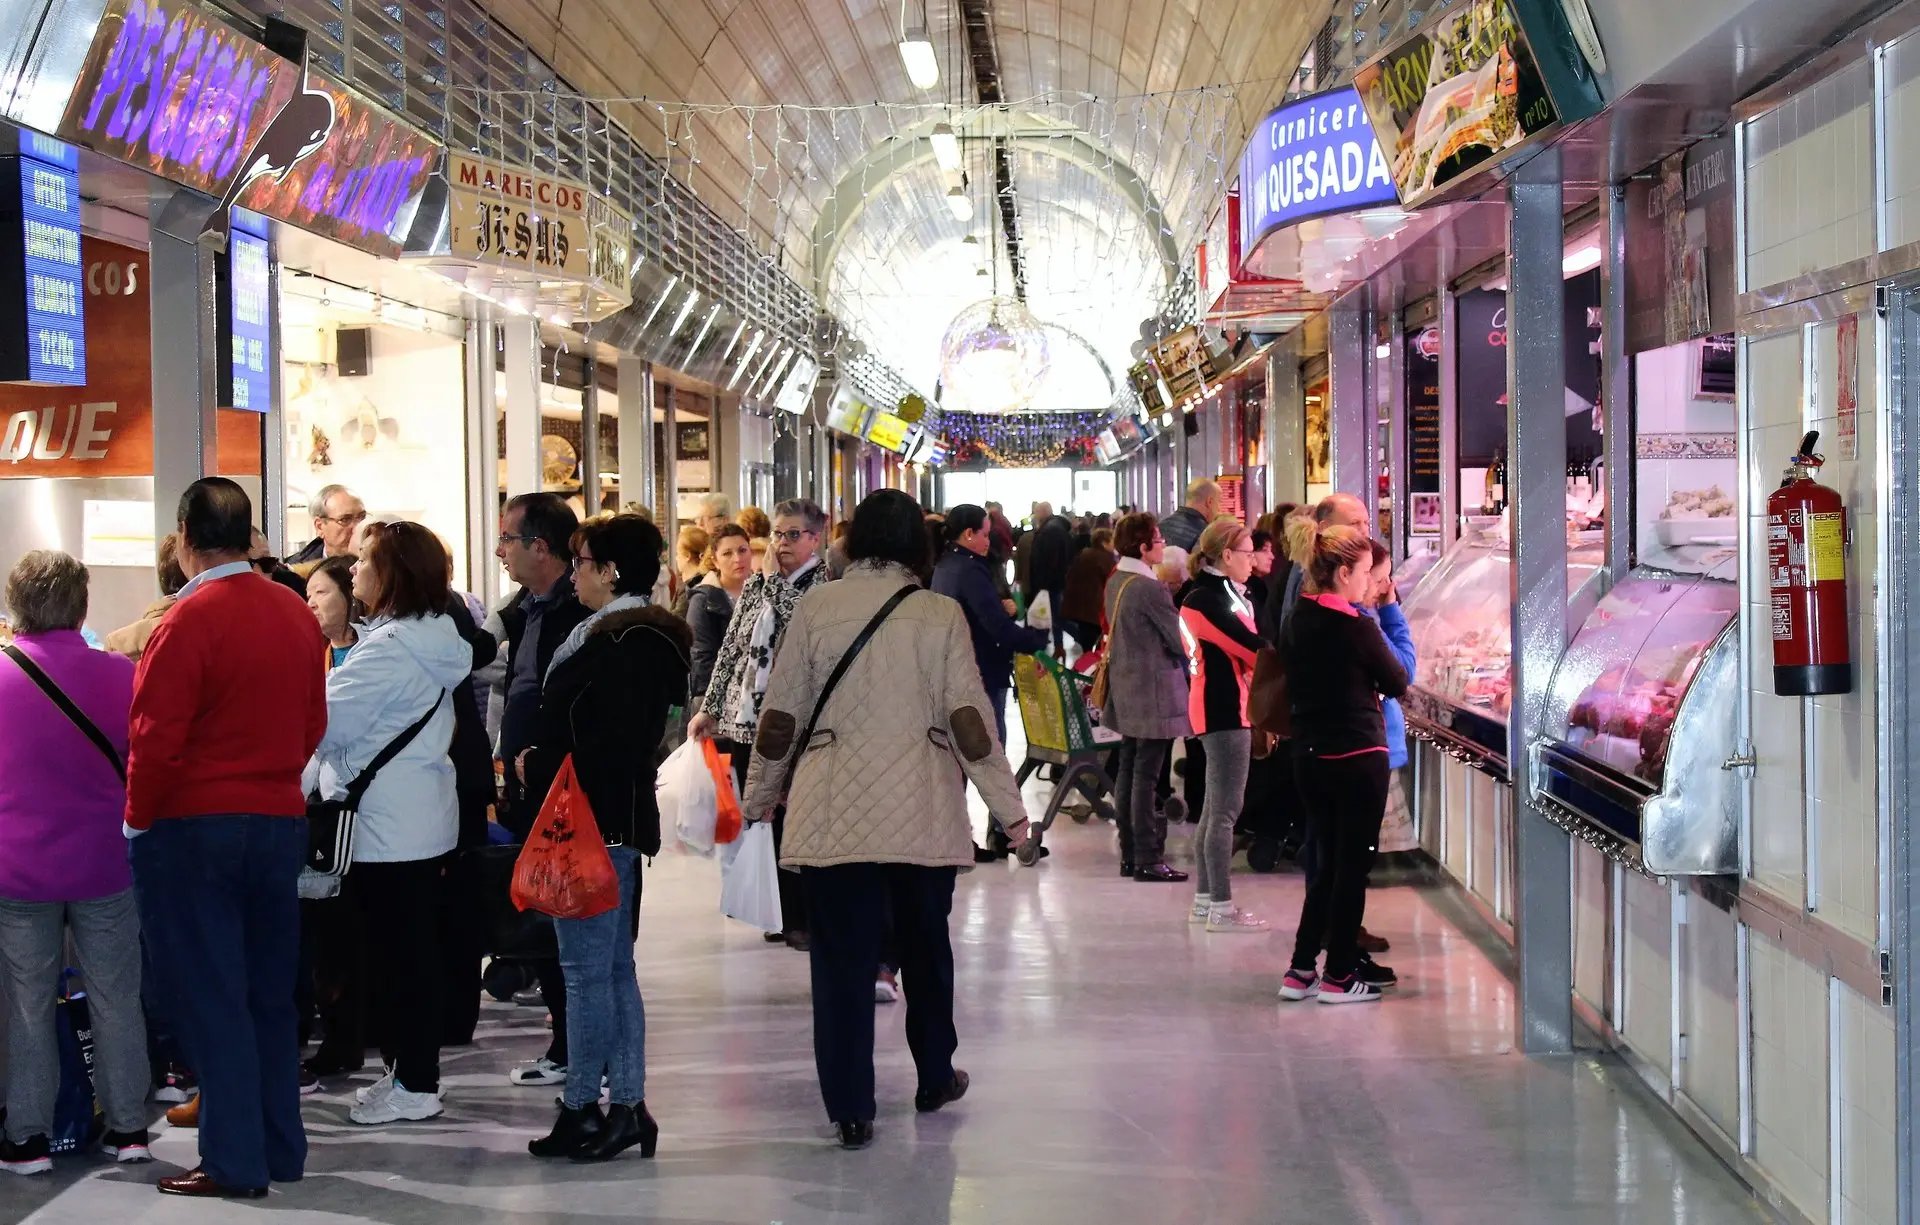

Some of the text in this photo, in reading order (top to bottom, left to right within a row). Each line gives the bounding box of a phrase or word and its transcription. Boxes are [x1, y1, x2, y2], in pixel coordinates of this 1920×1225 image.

[34, 169, 68, 213] OFERTA
[460, 162, 583, 211] MARISCOS
[1269, 137, 1391, 213] QUESADA
[87, 262, 140, 297] COS
[0, 402, 118, 465] QUE
